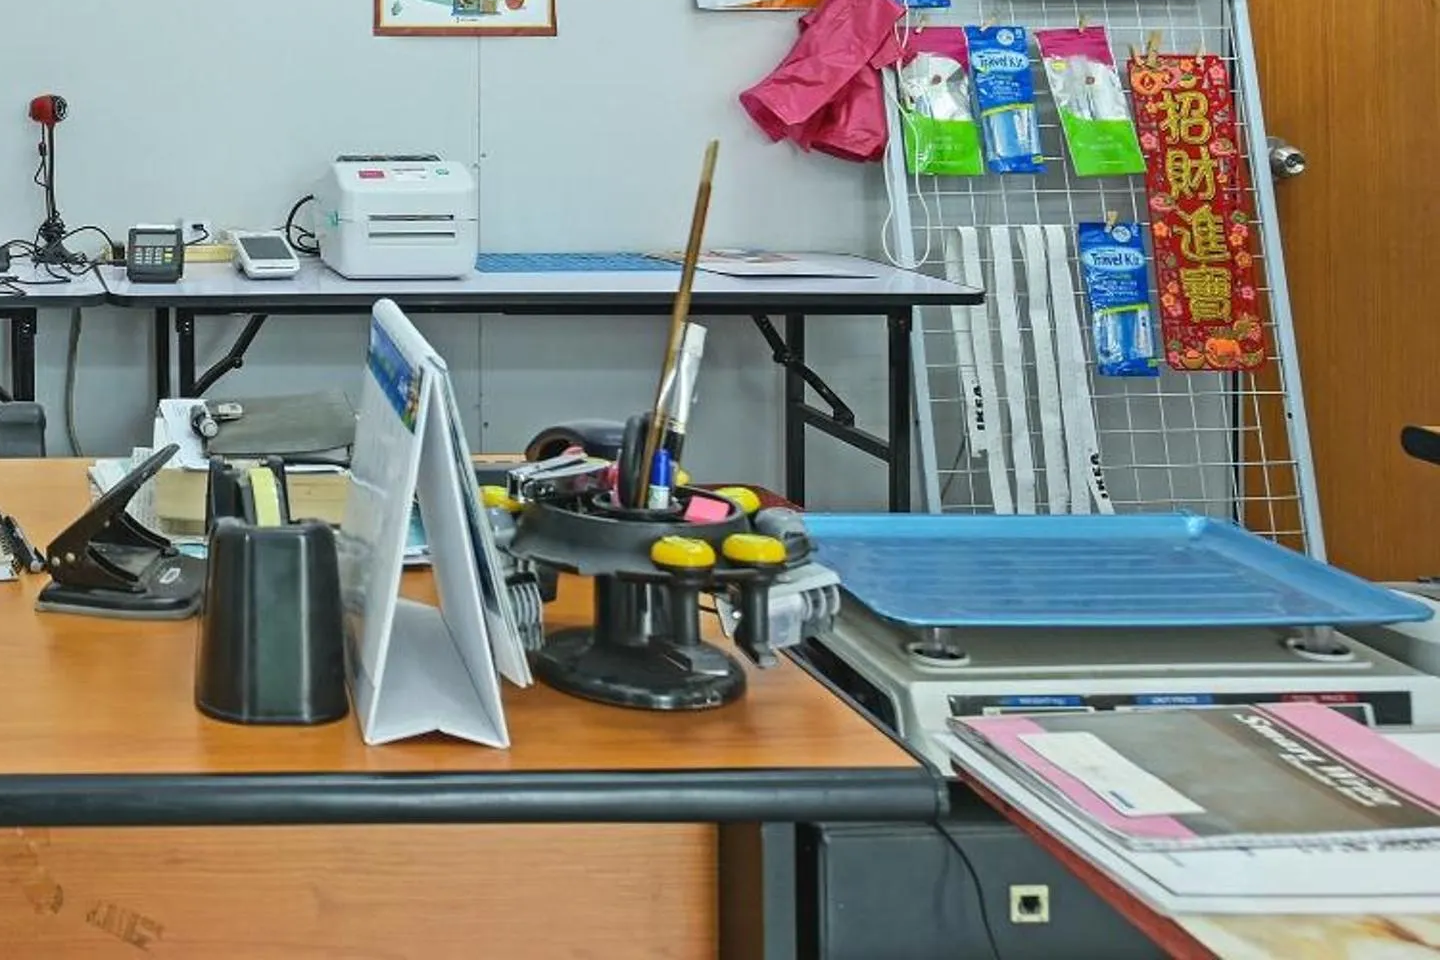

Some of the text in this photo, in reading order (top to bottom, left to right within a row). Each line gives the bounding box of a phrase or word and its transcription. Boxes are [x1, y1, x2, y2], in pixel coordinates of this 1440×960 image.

[978, 54, 1007, 67] Travel
[1158, 90, 1233, 323] 招財進寶
[1090, 251, 1140, 266] Travel Kit
[973, 385, 986, 431] IKEA
